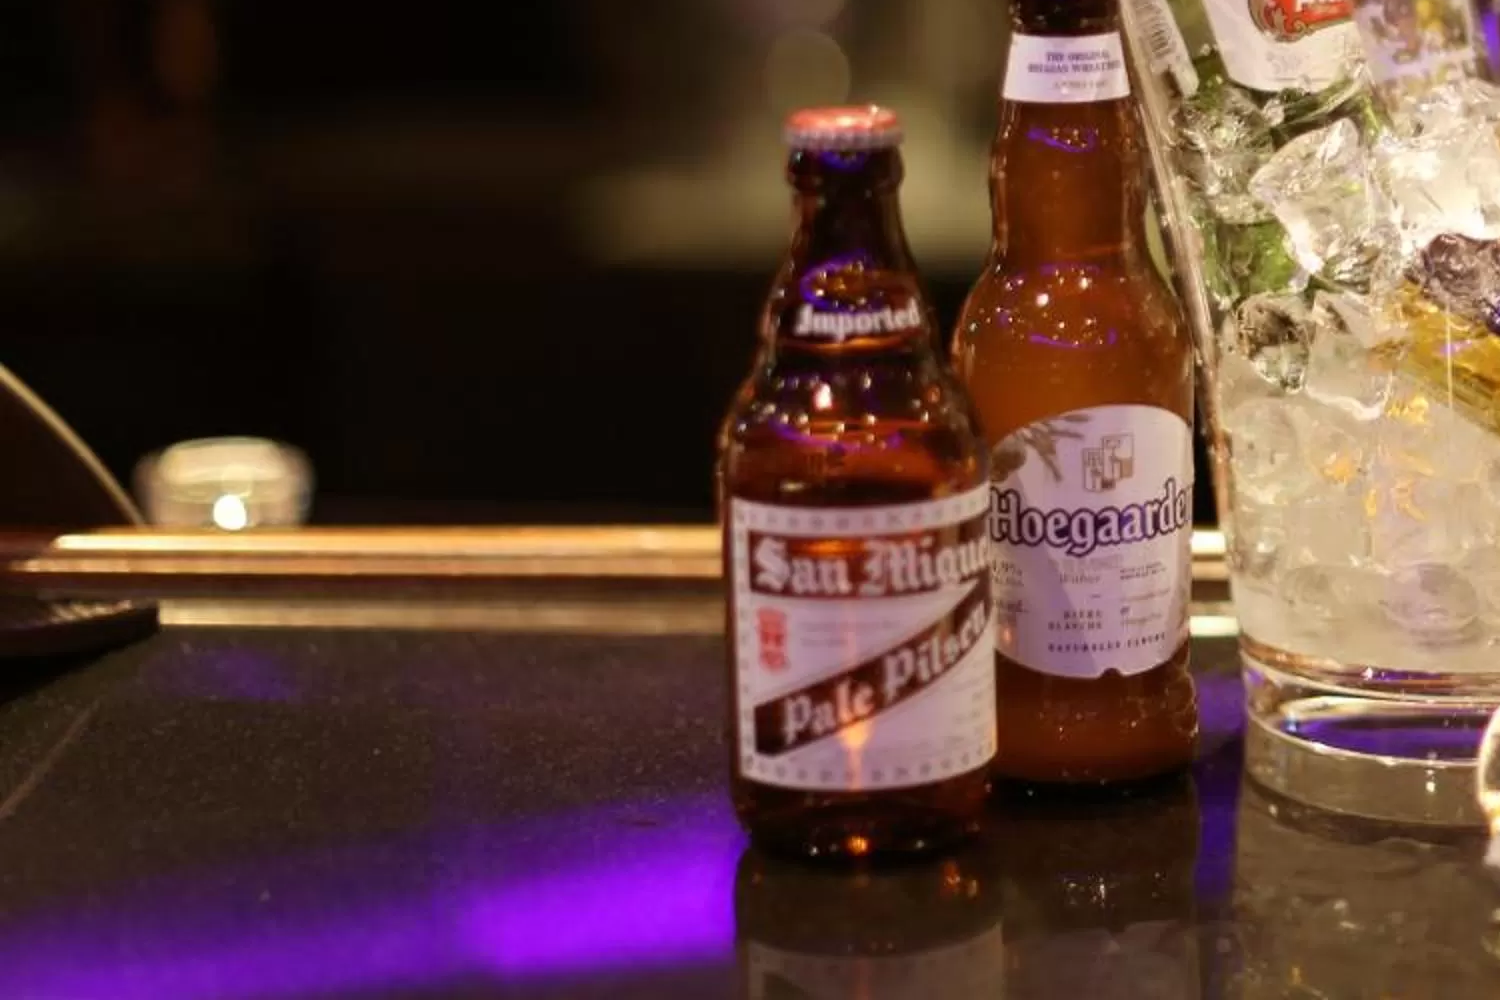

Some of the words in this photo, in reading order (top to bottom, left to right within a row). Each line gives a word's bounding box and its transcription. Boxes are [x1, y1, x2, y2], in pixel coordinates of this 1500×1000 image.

[795, 298, 921, 342] Imported
[754, 535, 852, 595] San
[858, 534, 990, 597] Migue
[783, 679, 877, 748] Pale
[882, 601, 989, 703] Pilsen
